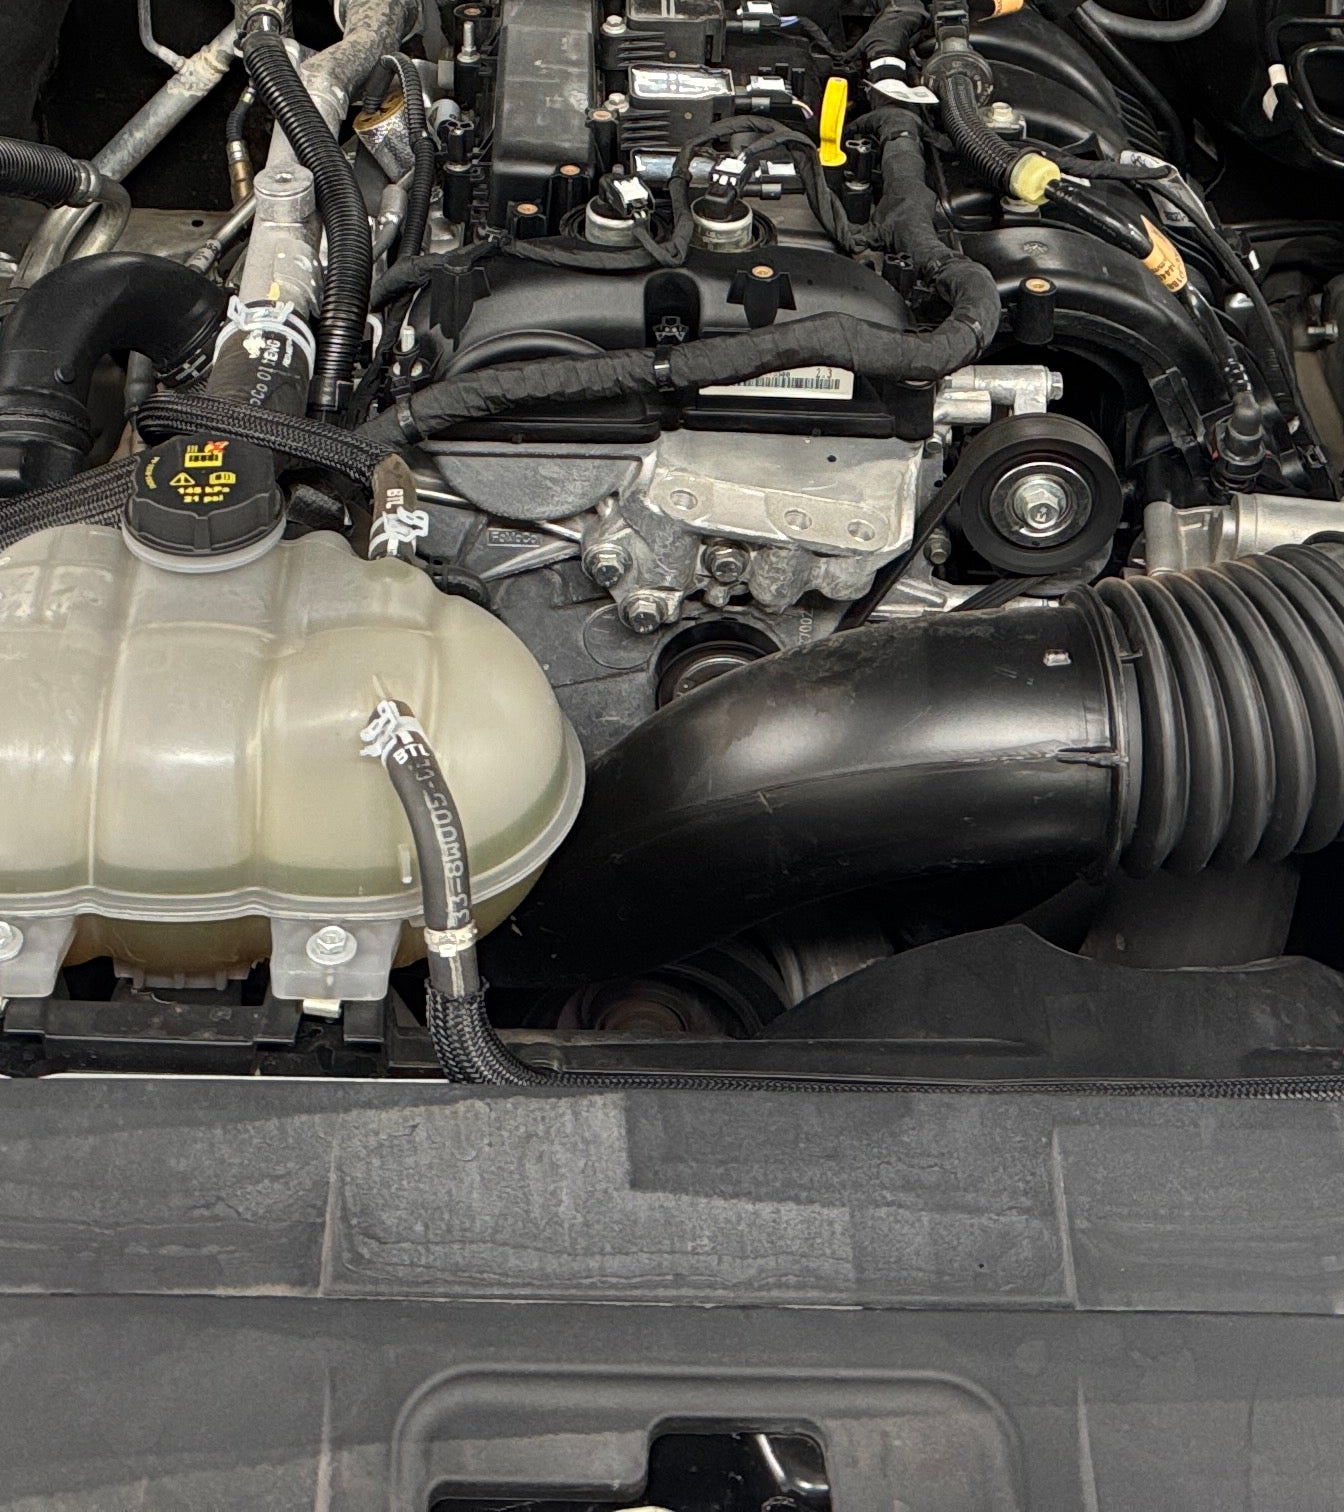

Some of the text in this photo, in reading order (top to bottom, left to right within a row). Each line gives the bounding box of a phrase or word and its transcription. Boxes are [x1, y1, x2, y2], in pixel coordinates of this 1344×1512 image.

[205, 486, 230, 494] kPa
[183, 494, 224, 504] 21 psi
[386, 488, 404, 509] BTL
[491, 530, 538, 544] FoMoCo
[393, 743, 430, 766] BTL
